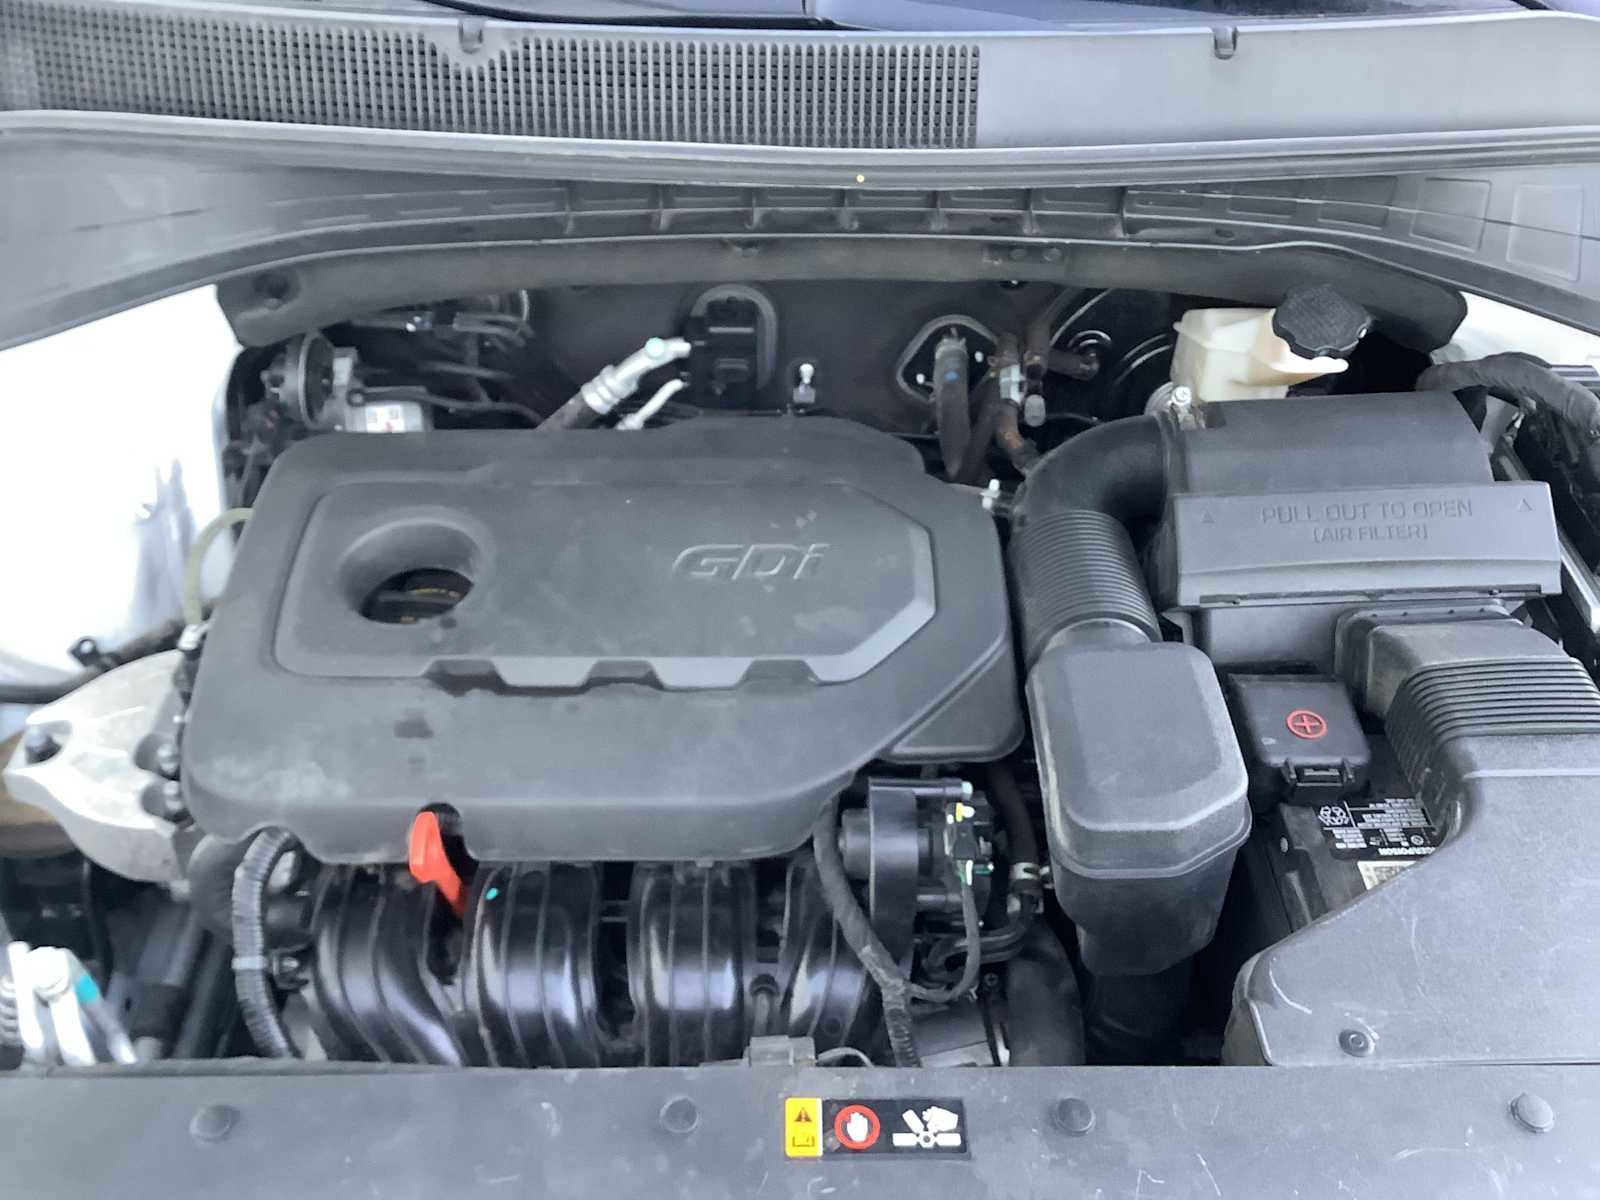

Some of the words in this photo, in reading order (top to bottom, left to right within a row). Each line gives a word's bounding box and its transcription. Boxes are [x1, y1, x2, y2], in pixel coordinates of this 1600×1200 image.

[1261, 503, 1321, 525] PULL
[1325, 502, 1371, 521] OUT
[1377, 501, 1406, 519] TO
[1413, 498, 1472, 518] OPEN
